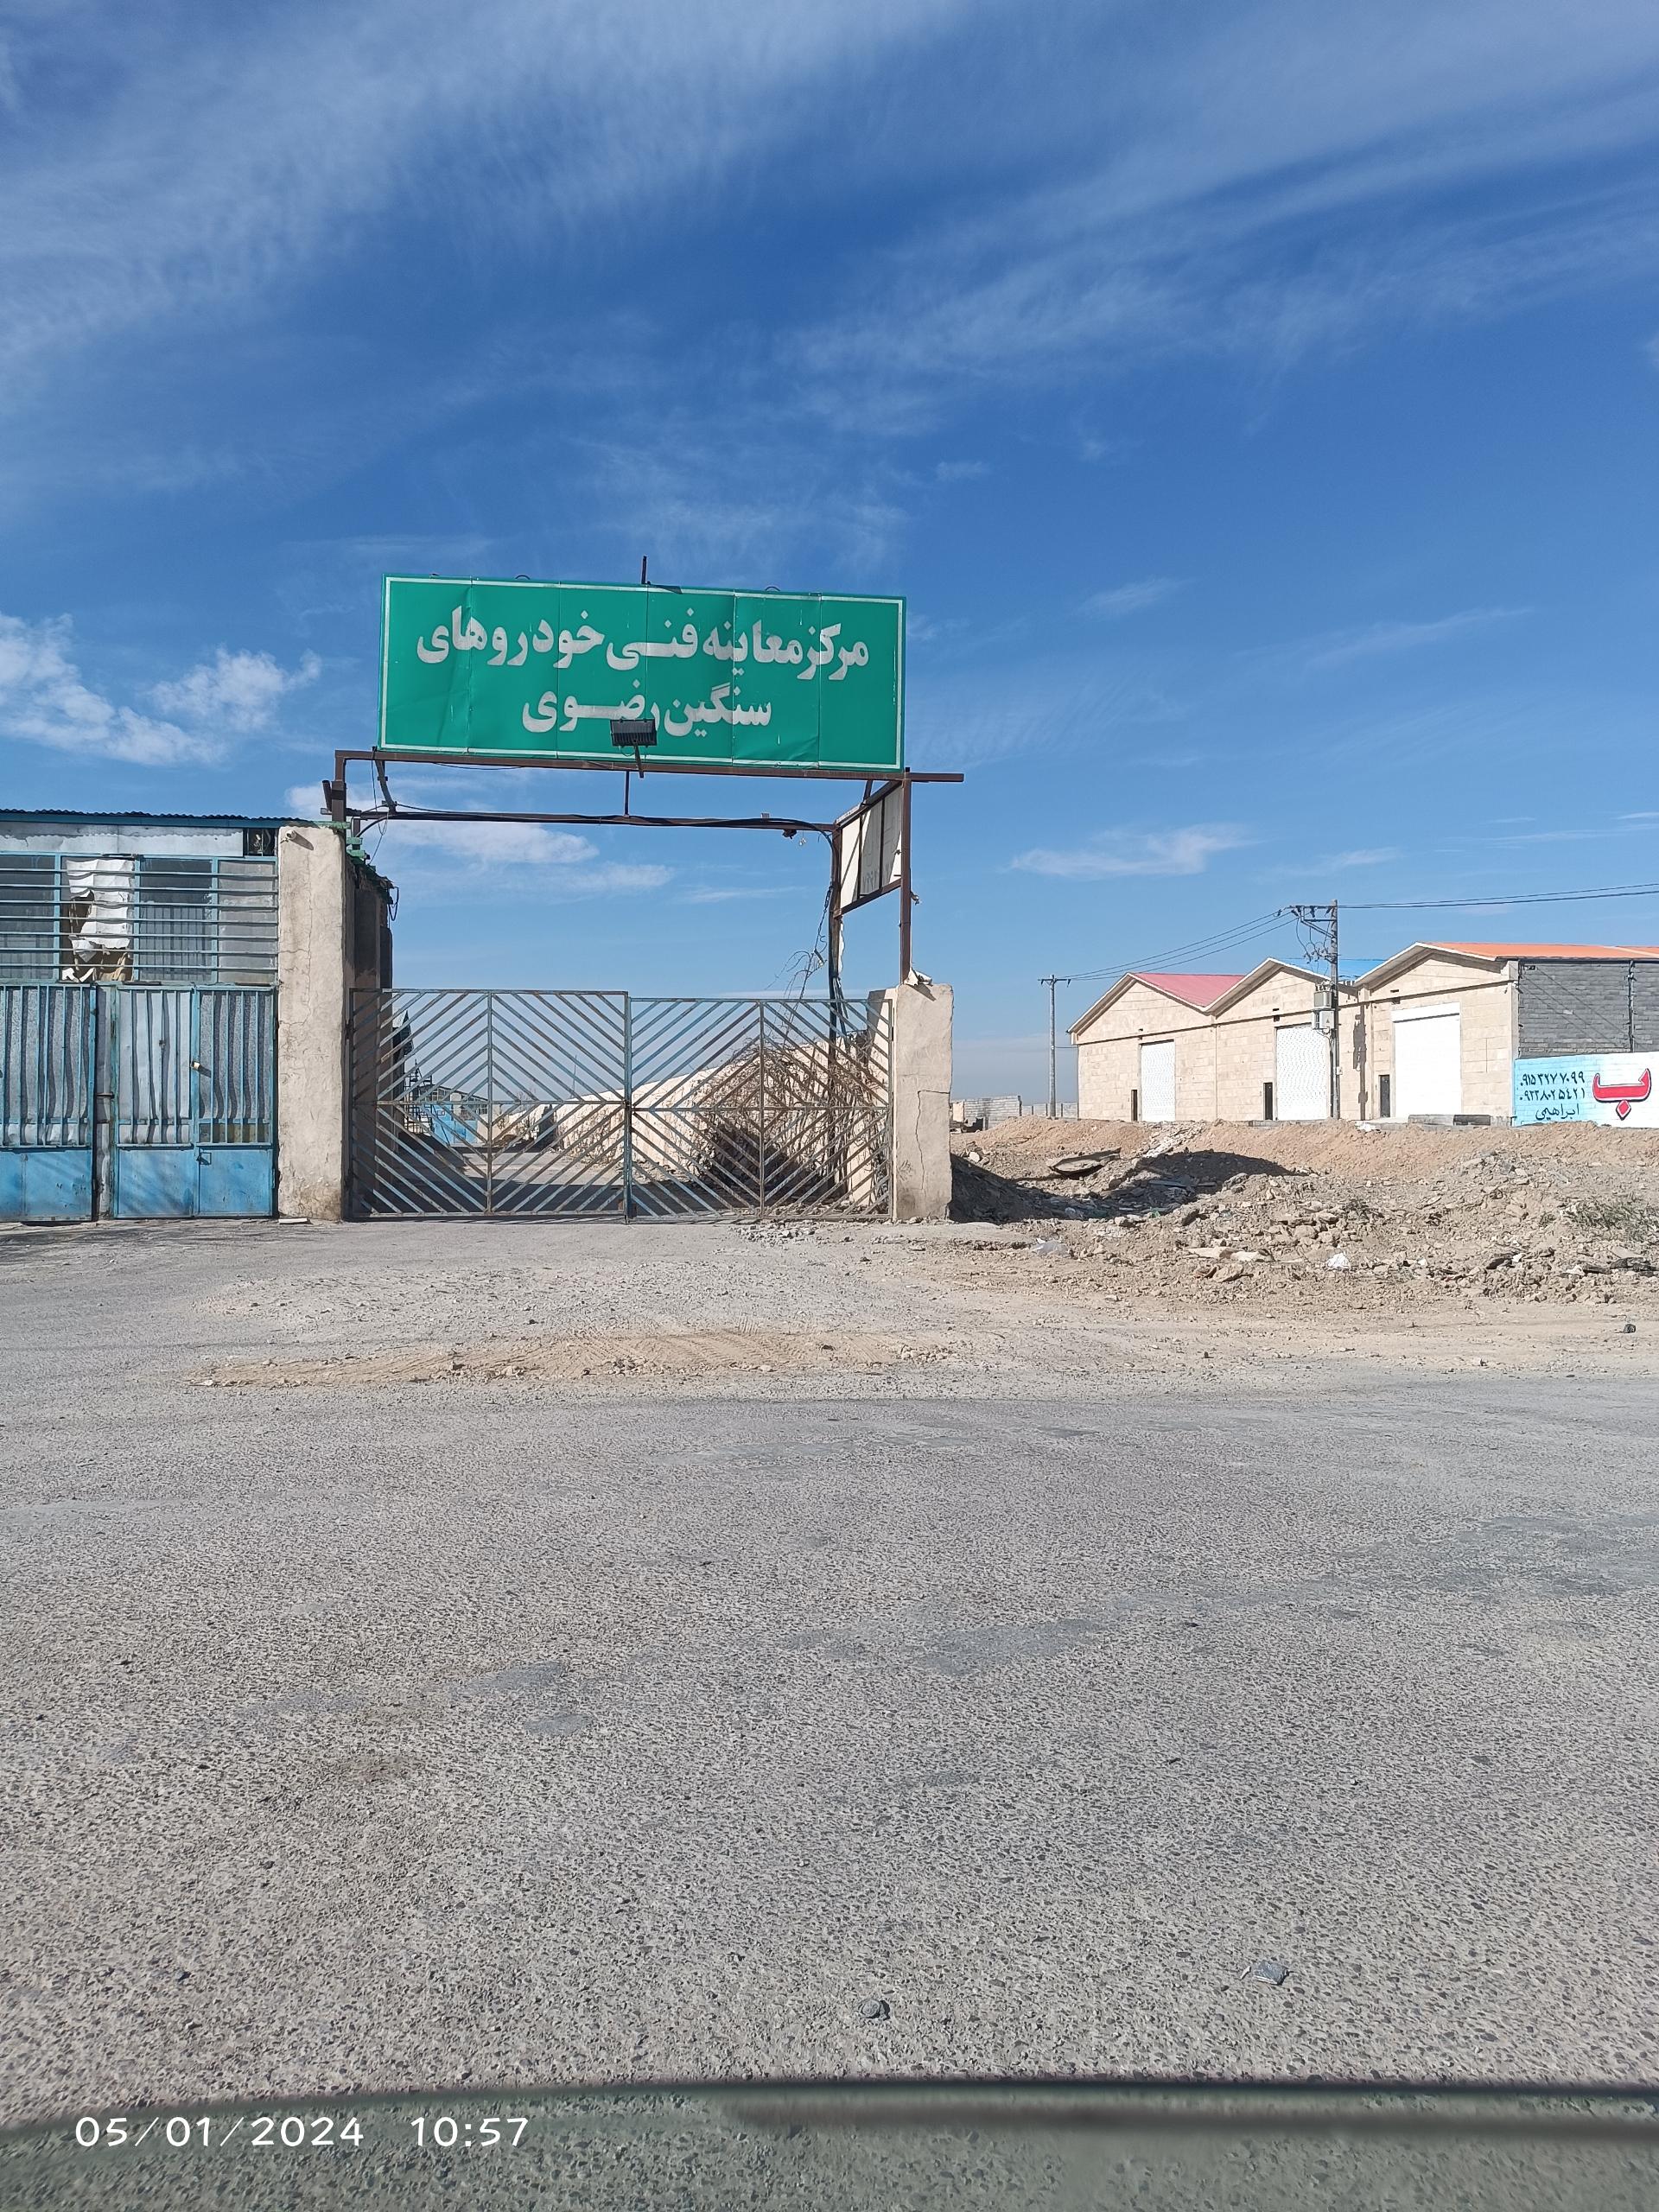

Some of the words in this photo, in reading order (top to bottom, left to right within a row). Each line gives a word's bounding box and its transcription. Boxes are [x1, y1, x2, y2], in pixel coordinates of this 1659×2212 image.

[607, 607, 698, 671] فنی
[702, 620, 804, 677] معاینه
[797, 622, 869, 681] مرکز
[522, 678, 661, 734] رضوی
[664, 682, 772, 737] سنگین
